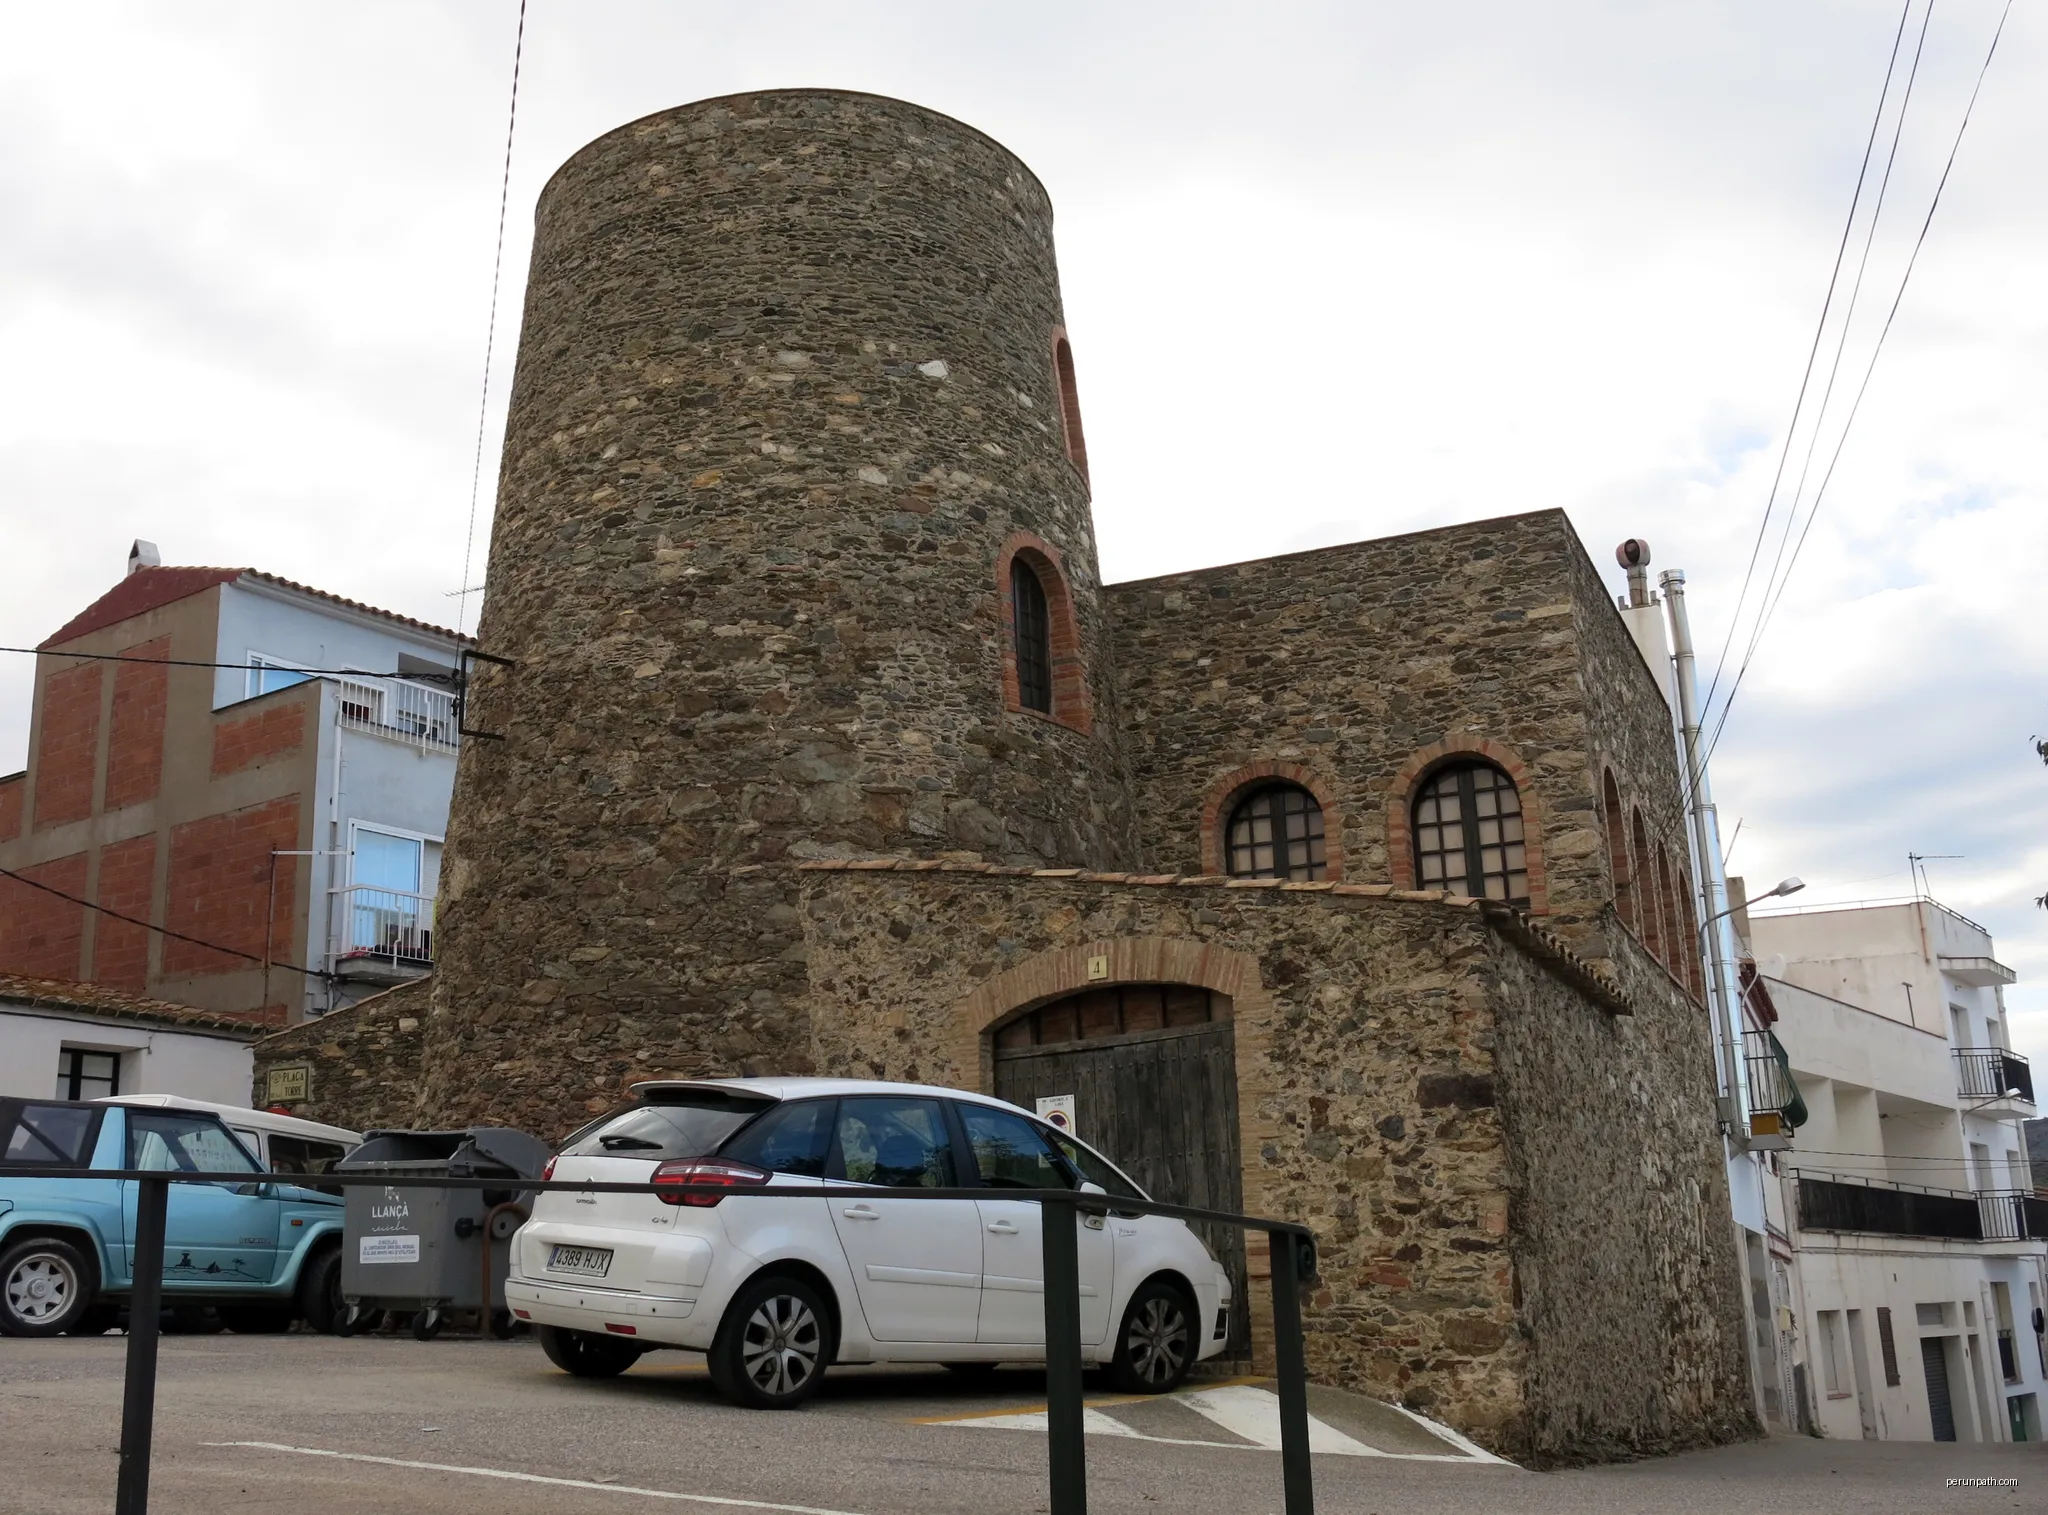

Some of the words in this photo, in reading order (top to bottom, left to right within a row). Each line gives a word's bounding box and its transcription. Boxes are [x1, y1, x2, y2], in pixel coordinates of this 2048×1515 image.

[1093, 961, 1100, 974] 4
[284, 1085, 302, 1097] TORRE
[372, 1201, 409, 1220] LLANÇÀ
[556, 1248, 582, 1267] 4389
[583, 1250, 608, 1271] HJX
